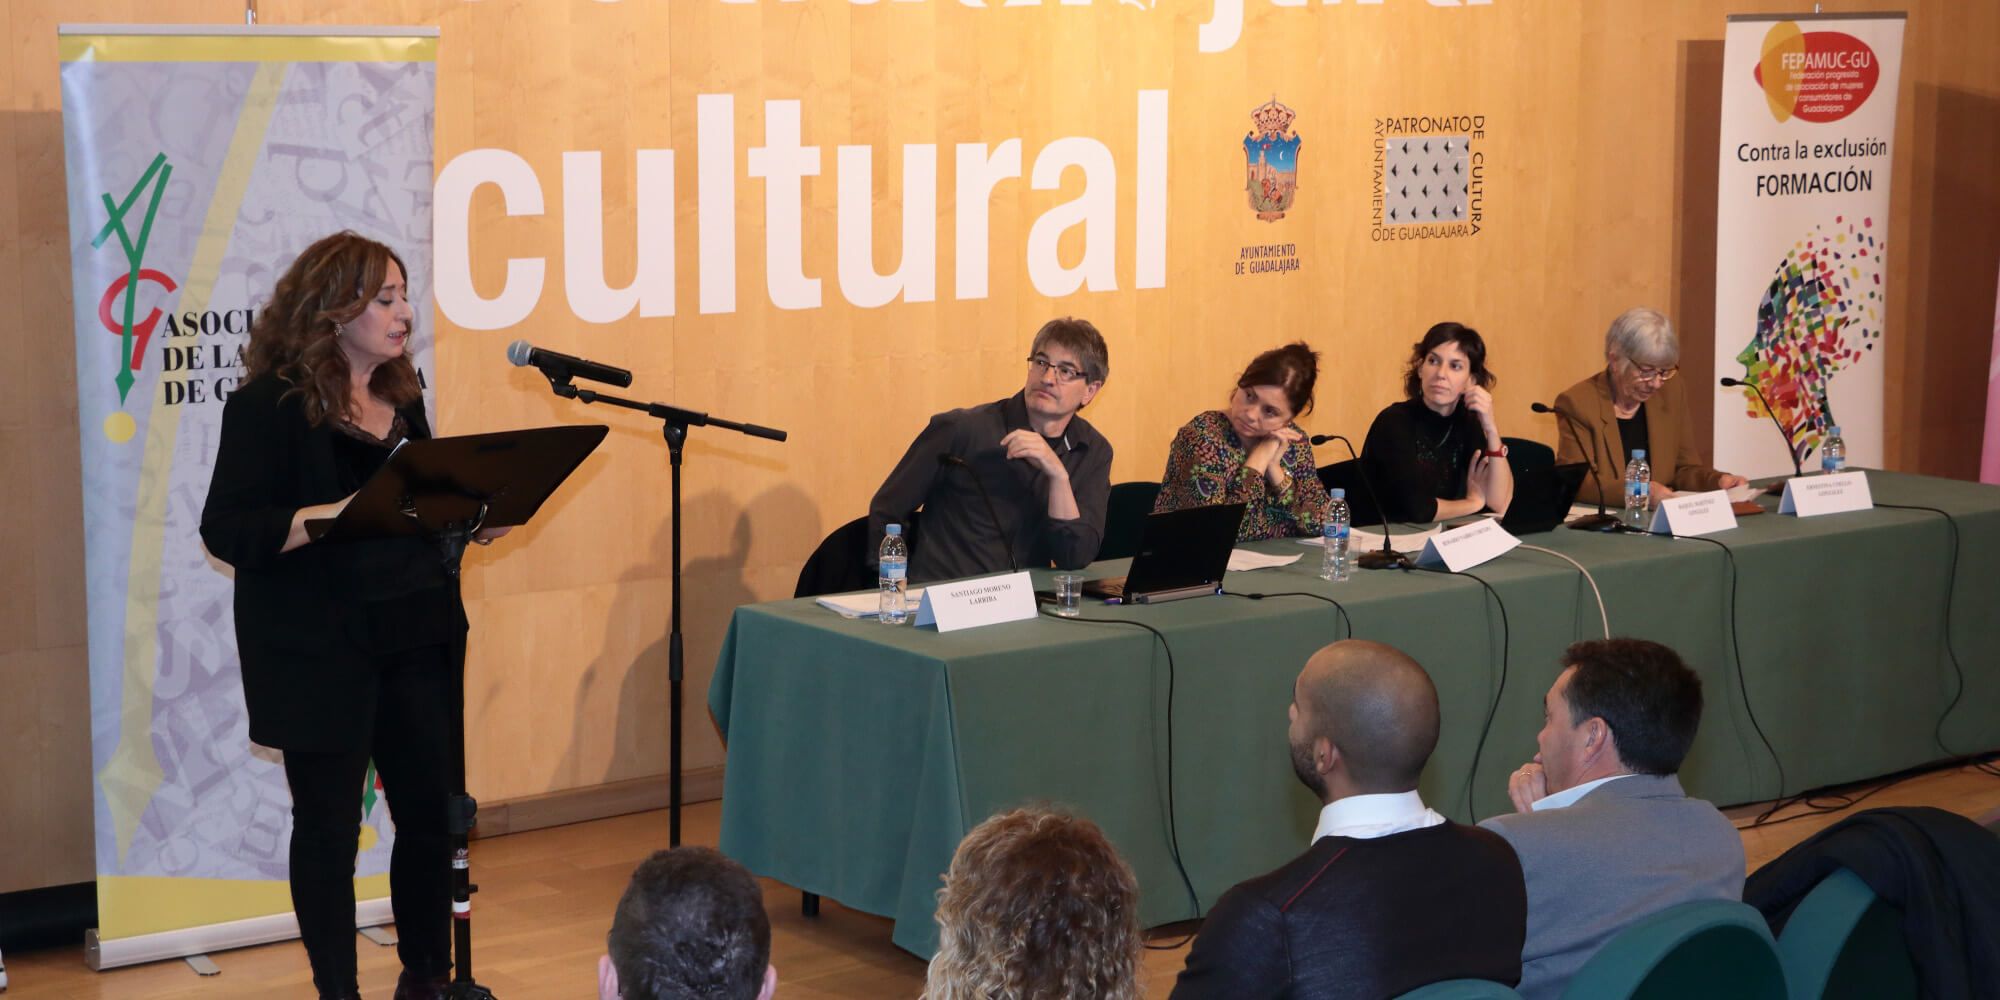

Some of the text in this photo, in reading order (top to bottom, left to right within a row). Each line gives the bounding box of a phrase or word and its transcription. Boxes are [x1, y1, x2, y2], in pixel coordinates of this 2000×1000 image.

[1781, 51, 1871, 70] FEPAMUC-GU
[1803, 104, 1845, 113] Guadalajara
[1386, 115, 1472, 133] PATRONATO
[1737, 137, 1887, 162] Contra la exclusión
[1471, 115, 1485, 236] DE CULTURA
[1756, 166, 1873, 197] FORMACIÓN
[433, 90, 1168, 330] cultural
[1382, 224, 1469, 240] DE GUADALAJARA
[1241, 244, 1296, 259] AYUNTAMIENTO
[1235, 258, 1300, 275] DE GUADALAJARA
[161, 309, 254, 338] ASOCI
[162, 343, 246, 371] DE LA
[164, 379, 206, 405] DE
[950, 584, 1011, 598] SANTIAGO MORENO
